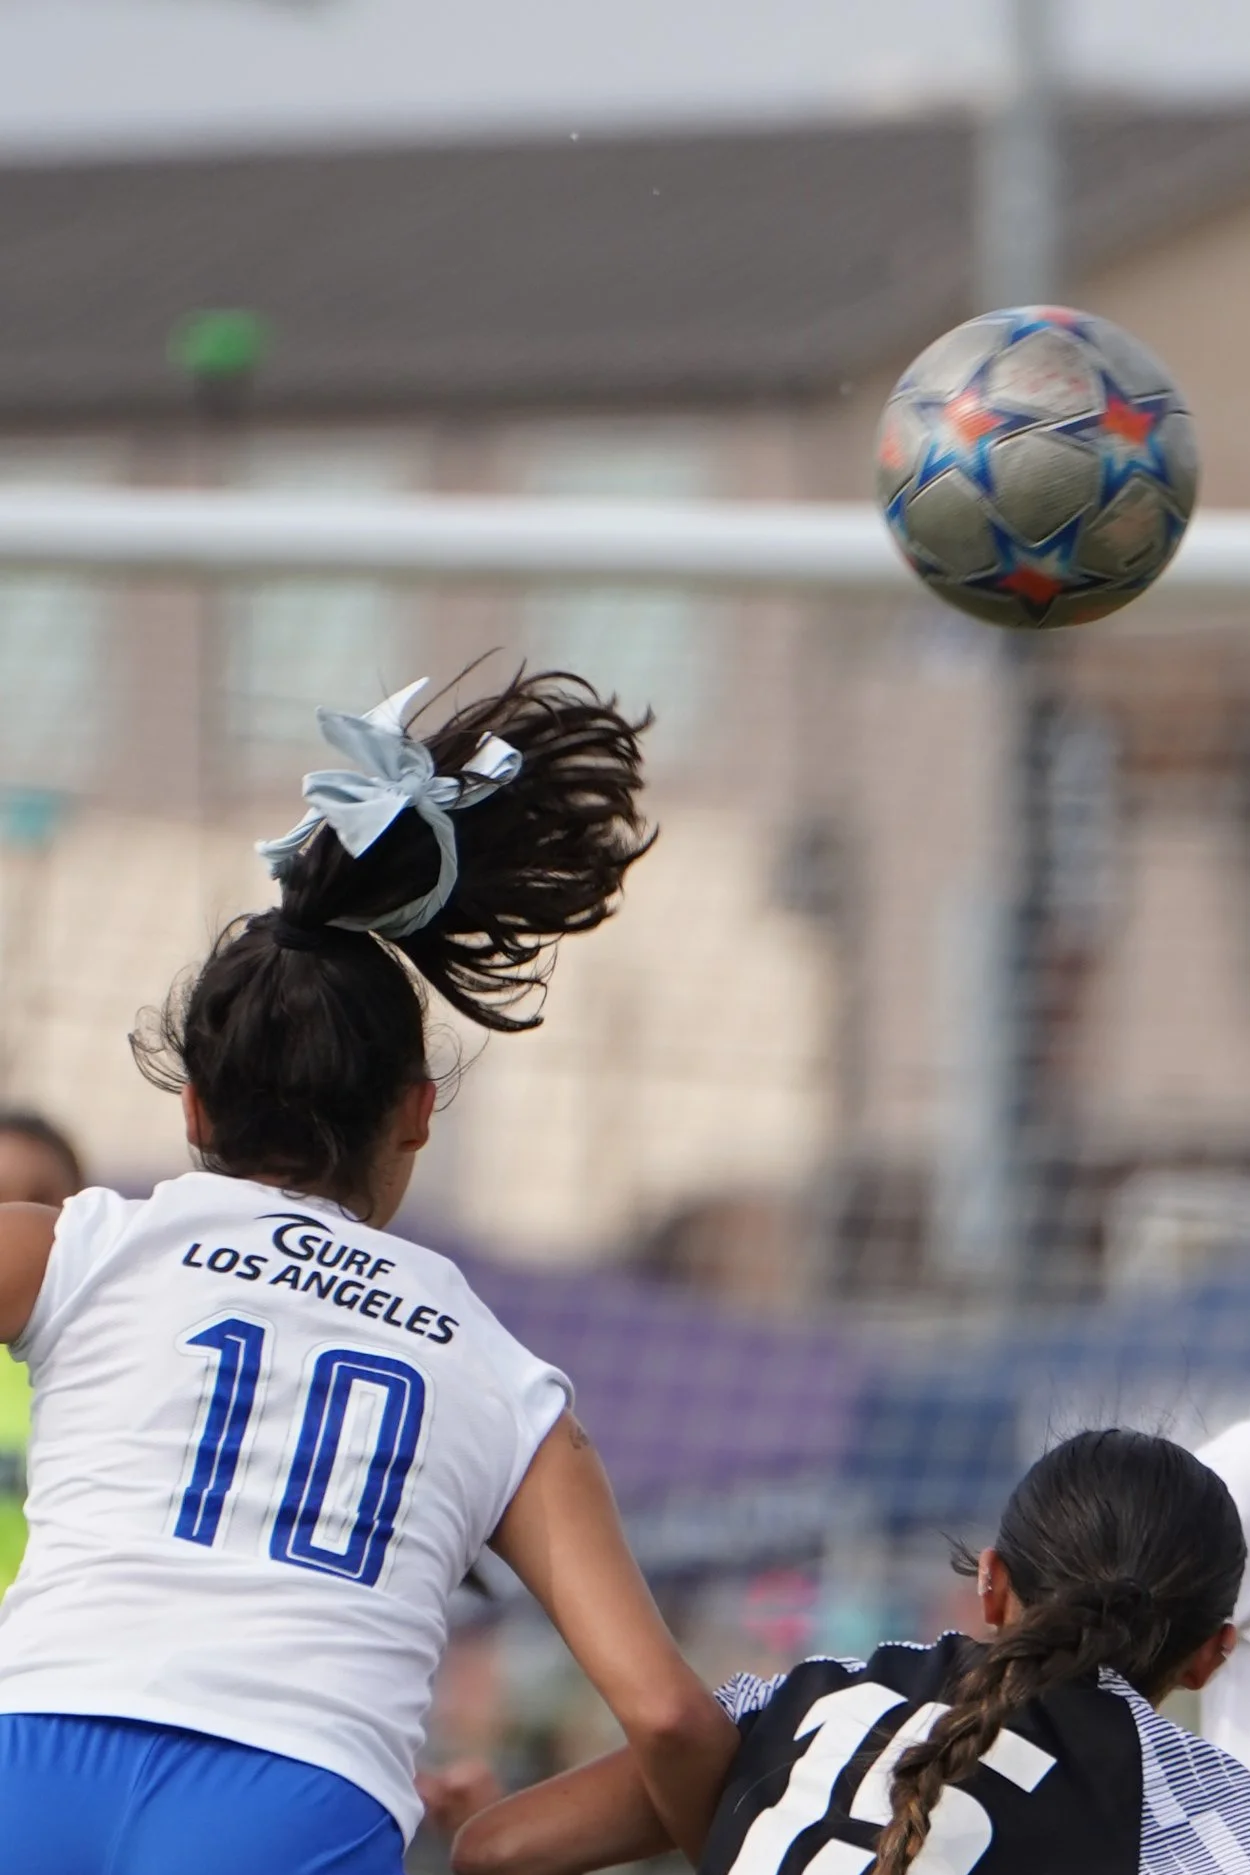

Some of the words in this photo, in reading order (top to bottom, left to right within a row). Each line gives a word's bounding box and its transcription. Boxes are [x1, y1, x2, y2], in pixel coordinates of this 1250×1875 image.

[182, 1242, 268, 1281] LOS
[269, 1265, 460, 1345] ANGELES
[289, 1231, 396, 1280] SURF
[173, 1317, 426, 1588] 10
